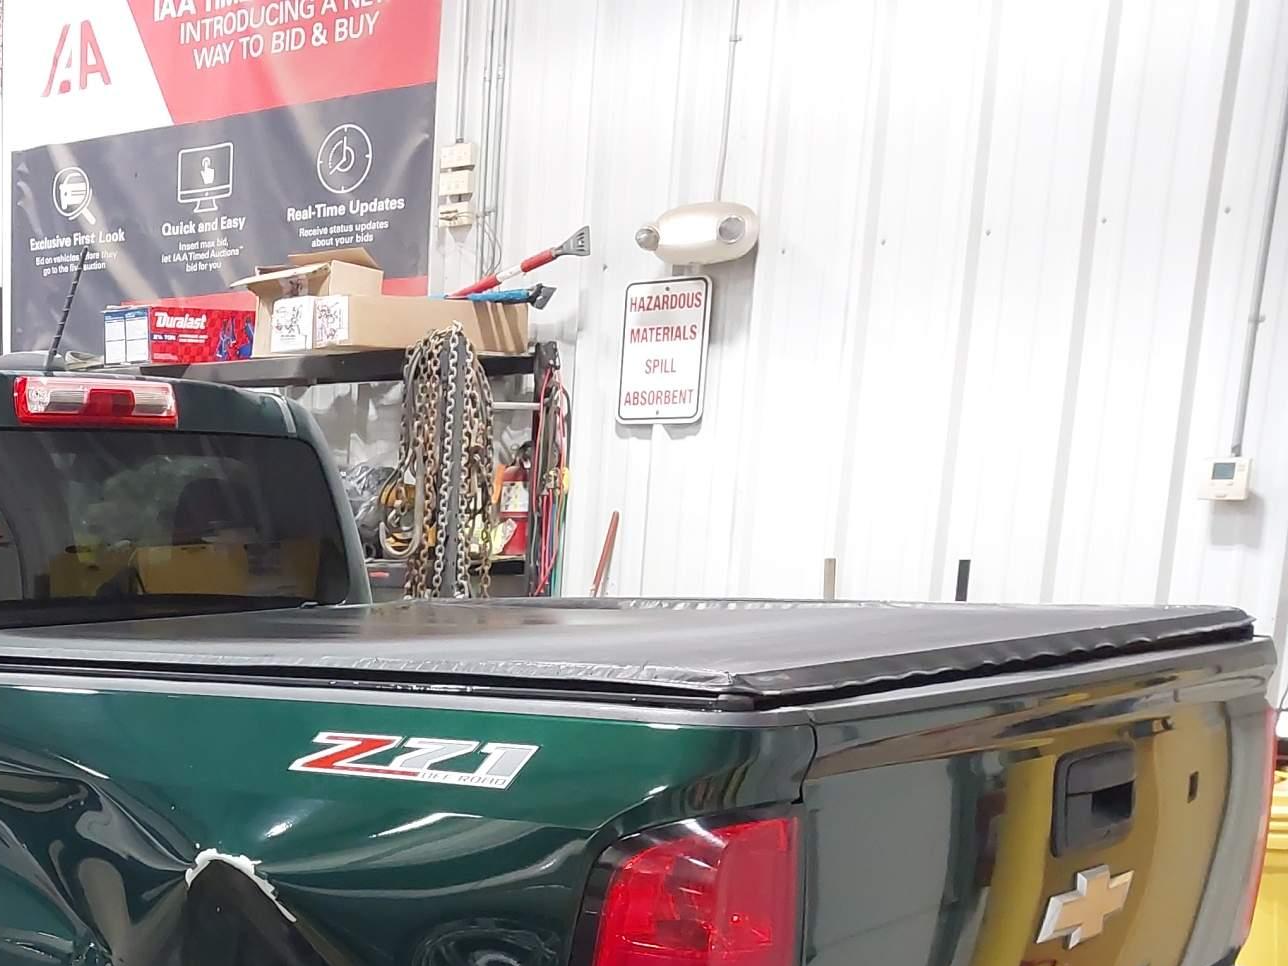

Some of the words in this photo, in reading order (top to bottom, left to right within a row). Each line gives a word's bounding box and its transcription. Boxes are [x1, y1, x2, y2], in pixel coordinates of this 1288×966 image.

[179, 0, 314, 44] INTRODUCING
[320, 0, 338, 15] A
[193, 40, 234, 70] WAY
[239, 34, 263, 59] TO
[271, 26, 305, 54] BID
[311, 22, 328, 47] &
[334, 10, 380, 42] BUY
[287, 203, 346, 222] Real-Time
[349, 197, 405, 216] Updates
[162, 219, 195, 237] Quick
[198, 218, 218, 232] and
[220, 215, 246, 231] Easy
[299, 226, 328, 238] Receive
[329, 223, 353, 234] status
[355, 220, 389, 232] updates
[30, 235, 72, 251] Exclusive
[73, 232, 96, 246] First
[98, 229, 125, 243] Look
[311, 236, 333, 248] about
[334, 236, 353, 247] your
[355, 233, 373, 243] bids
[172, 252, 188, 262] IAA
[188, 249, 209, 261] Timed
[43, 268, 51, 277] go
[52, 266, 58, 274] to
[58, 264, 69, 273] the
[185, 262, 197, 272] bid
[198, 261, 208, 271] for
[208, 262, 222, 271] you
[629, 291, 702, 312] HAZARDOUS
[154, 311, 207, 330] Duralast
[630, 324, 697, 344] MATERIALS
[644, 358, 677, 375] SPILL
[624, 389, 694, 406] ABSORBENT
[288, 732, 540, 788] Z71
